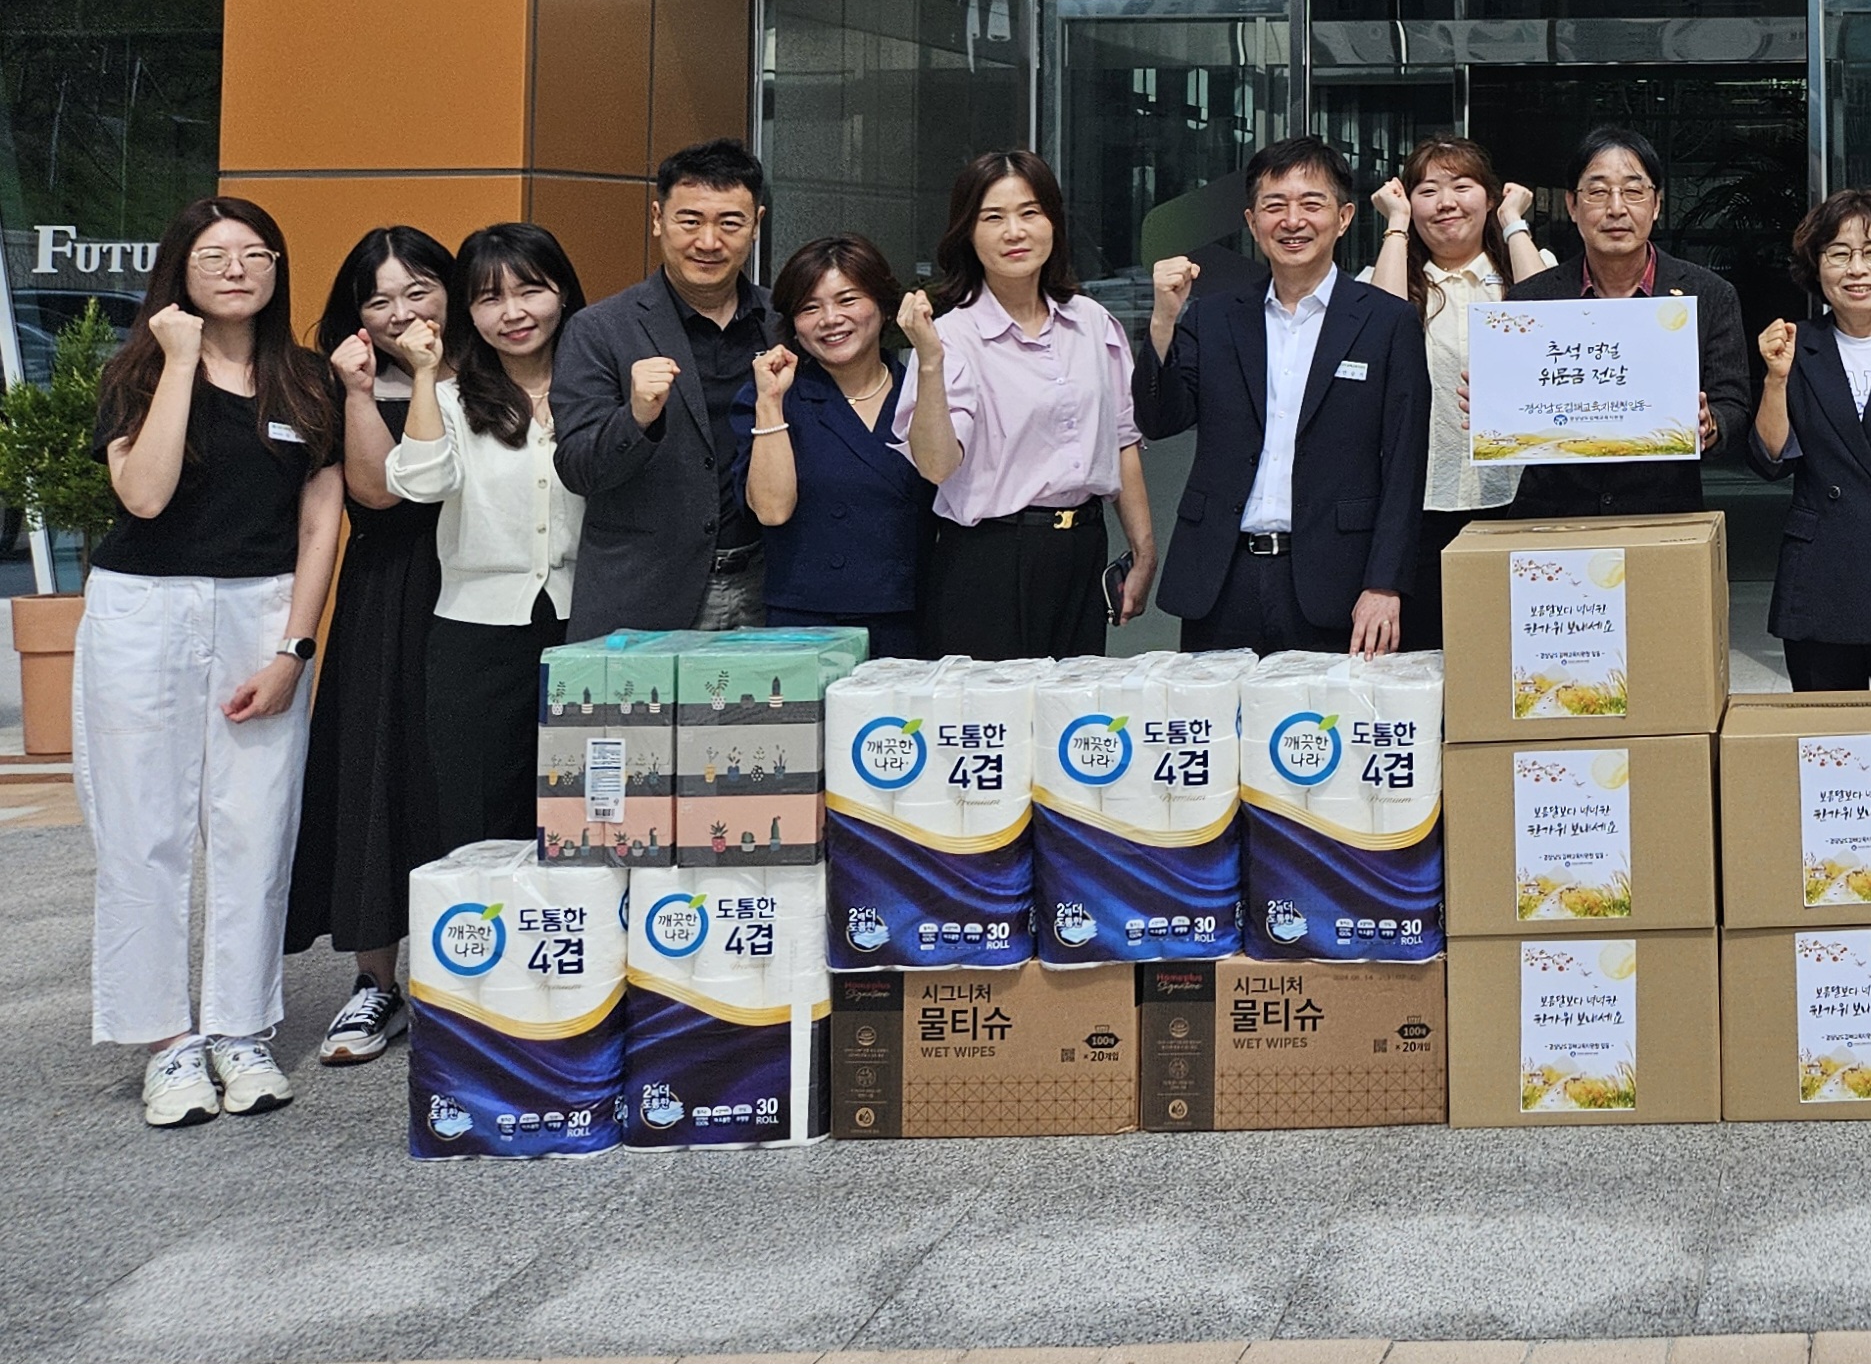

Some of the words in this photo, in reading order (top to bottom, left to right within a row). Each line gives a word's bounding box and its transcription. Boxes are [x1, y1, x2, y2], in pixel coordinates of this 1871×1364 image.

[1545, 341, 1581, 364] 추석
[1587, 342, 1621, 360] 명절
[1538, 367, 1585, 387] 위문금
[1591, 365, 1628, 386] 전달
[1531, 604, 1573, 617] 보름달보다
[1523, 621, 1563, 636] 한가위
[1567, 619, 1615, 635] 보내세요
[938, 723, 1006, 749] 도톰한
[1142, 719, 1212, 745] 도톰한
[1350, 721, 1416, 747] 도톰한
[867, 739, 913, 756] 깨끗한
[1073, 737, 1118, 755] 깨끗한
[1284, 733, 1329, 751] 깨끗한
[874, 756, 904, 772] 나라
[1081, 753, 1111, 769] 나라
[1290, 749, 1321, 768] 나라
[948, 754, 1003, 790] 4겹
[1153, 749, 1209, 786] 4겹
[1361, 751, 1414, 788] 4겹
[1820, 789, 1862, 803] 보름달보다
[1534, 804, 1577, 818] 보름달보다
[1813, 806, 1852, 822] 한가위
[1527, 821, 1566, 837] 한가위
[1571, 820, 1619, 836] 보내세요
[715, 897, 777, 919] 도톰한
[518, 907, 587, 934] 도톰한
[658, 912, 697, 928] 깨끗한
[1193, 916, 1216, 934] 30
[1401, 918, 1422, 935] 30
[447, 923, 492, 941] 깨끗한
[665, 928, 690, 942] 나라
[725, 923, 774, 956] 4겹
[986, 922, 1010, 940] 30
[1194, 933, 1217, 944] ROLL
[454, 940, 486, 957] 나라
[986, 939, 1010, 950] ROLL
[1400, 936, 1423, 946] ROLL
[527, 938, 585, 975] 4겹
[921, 983, 991, 1003] 시그니처
[1233, 975, 1303, 995] 시그니처
[1816, 985, 1858, 999] 보름달보다
[1540, 995, 1583, 1008] 보름달보다
[1809, 1002, 1849, 1018] 한가위
[917, 1006, 1012, 1041] 물티슈
[1229, 998, 1325, 1033] 물티슈
[1533, 1012, 1573, 1027] 한가위
[1577, 1011, 1625, 1026] 보내세요
[920, 1046, 951, 1058] WET
[954, 1046, 995, 1058] WIPES
[1233, 1038, 1263, 1050] WET
[1266, 1037, 1308, 1049] WIPES
[756, 1098, 778, 1115] 30
[567, 1110, 591, 1128] 30
[756, 1115, 779, 1124] ROLL
[566, 1127, 592, 1138] ROLL
